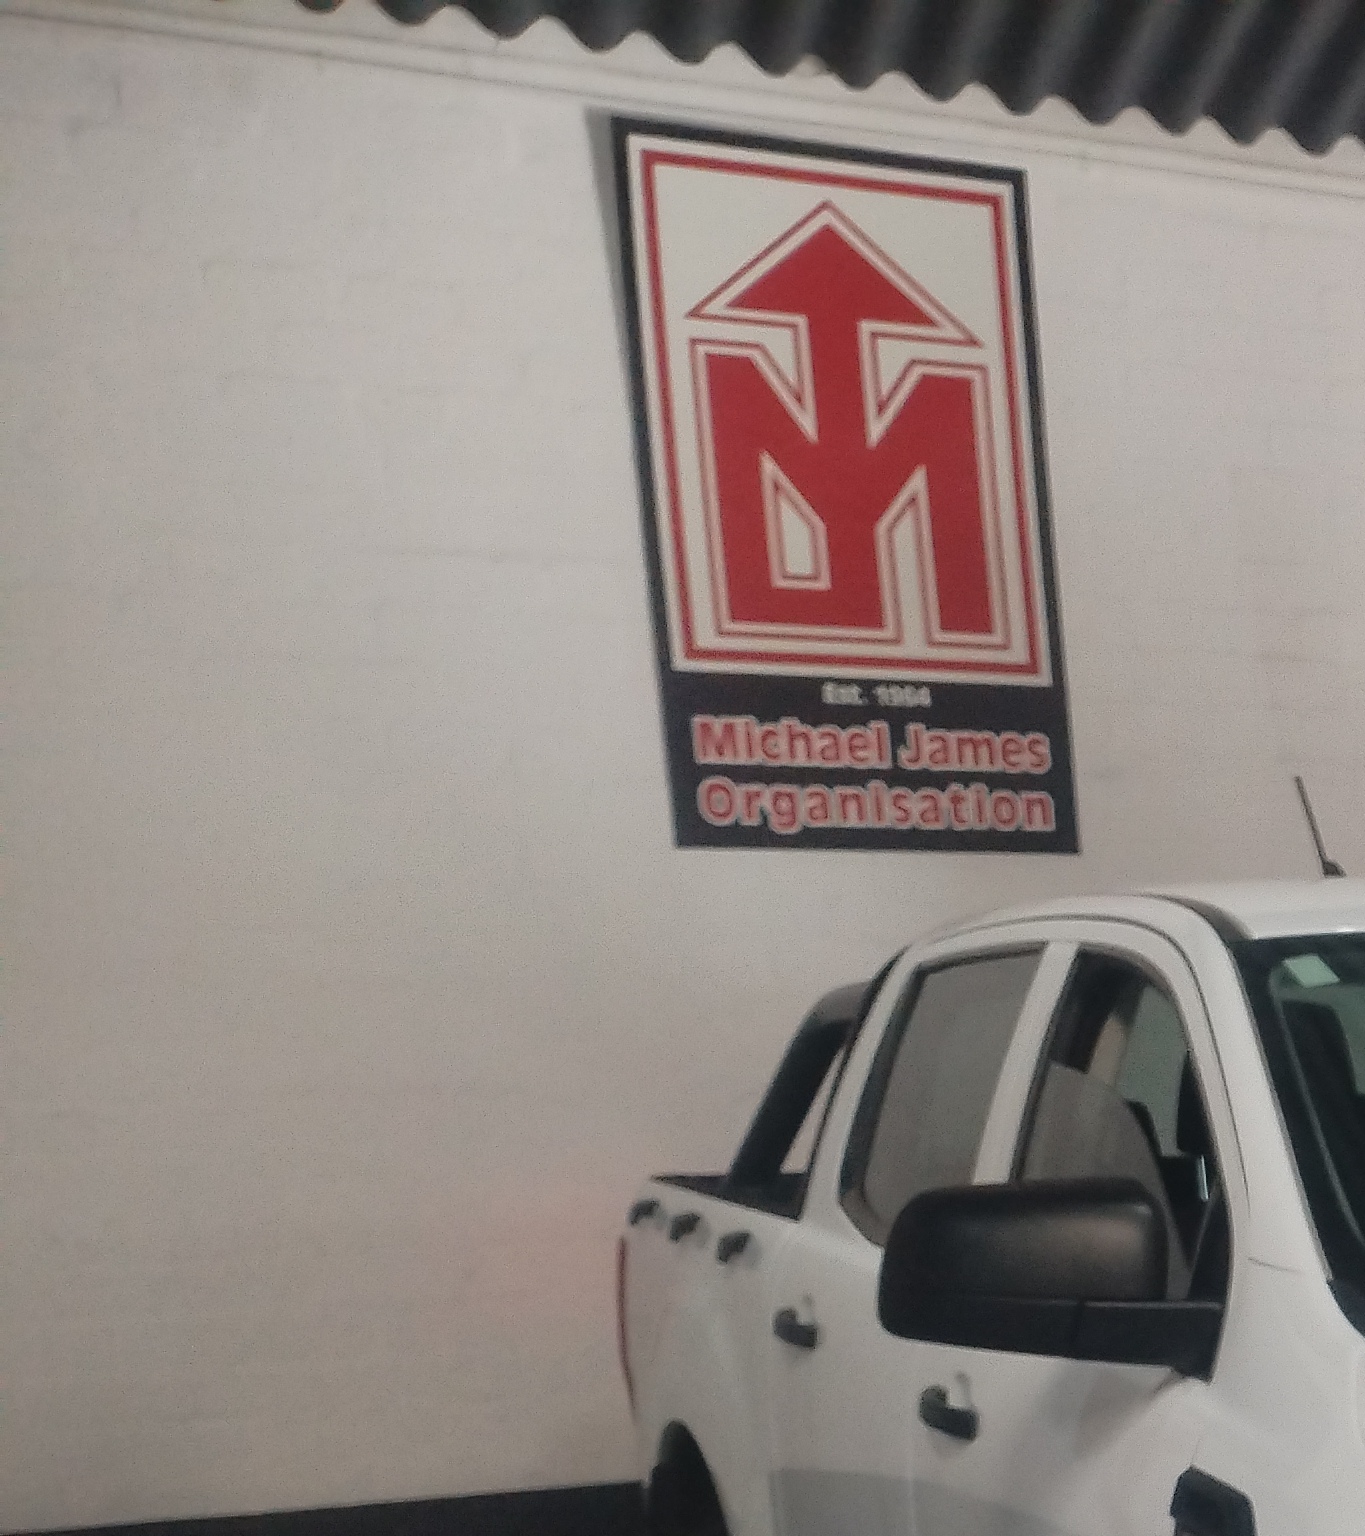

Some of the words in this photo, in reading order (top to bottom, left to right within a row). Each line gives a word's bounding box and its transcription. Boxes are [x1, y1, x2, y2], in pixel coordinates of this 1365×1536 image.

[692, 713, 892, 769] Michael
[897, 721, 1051, 775] James
[698, 775, 1056, 834] Organisation
